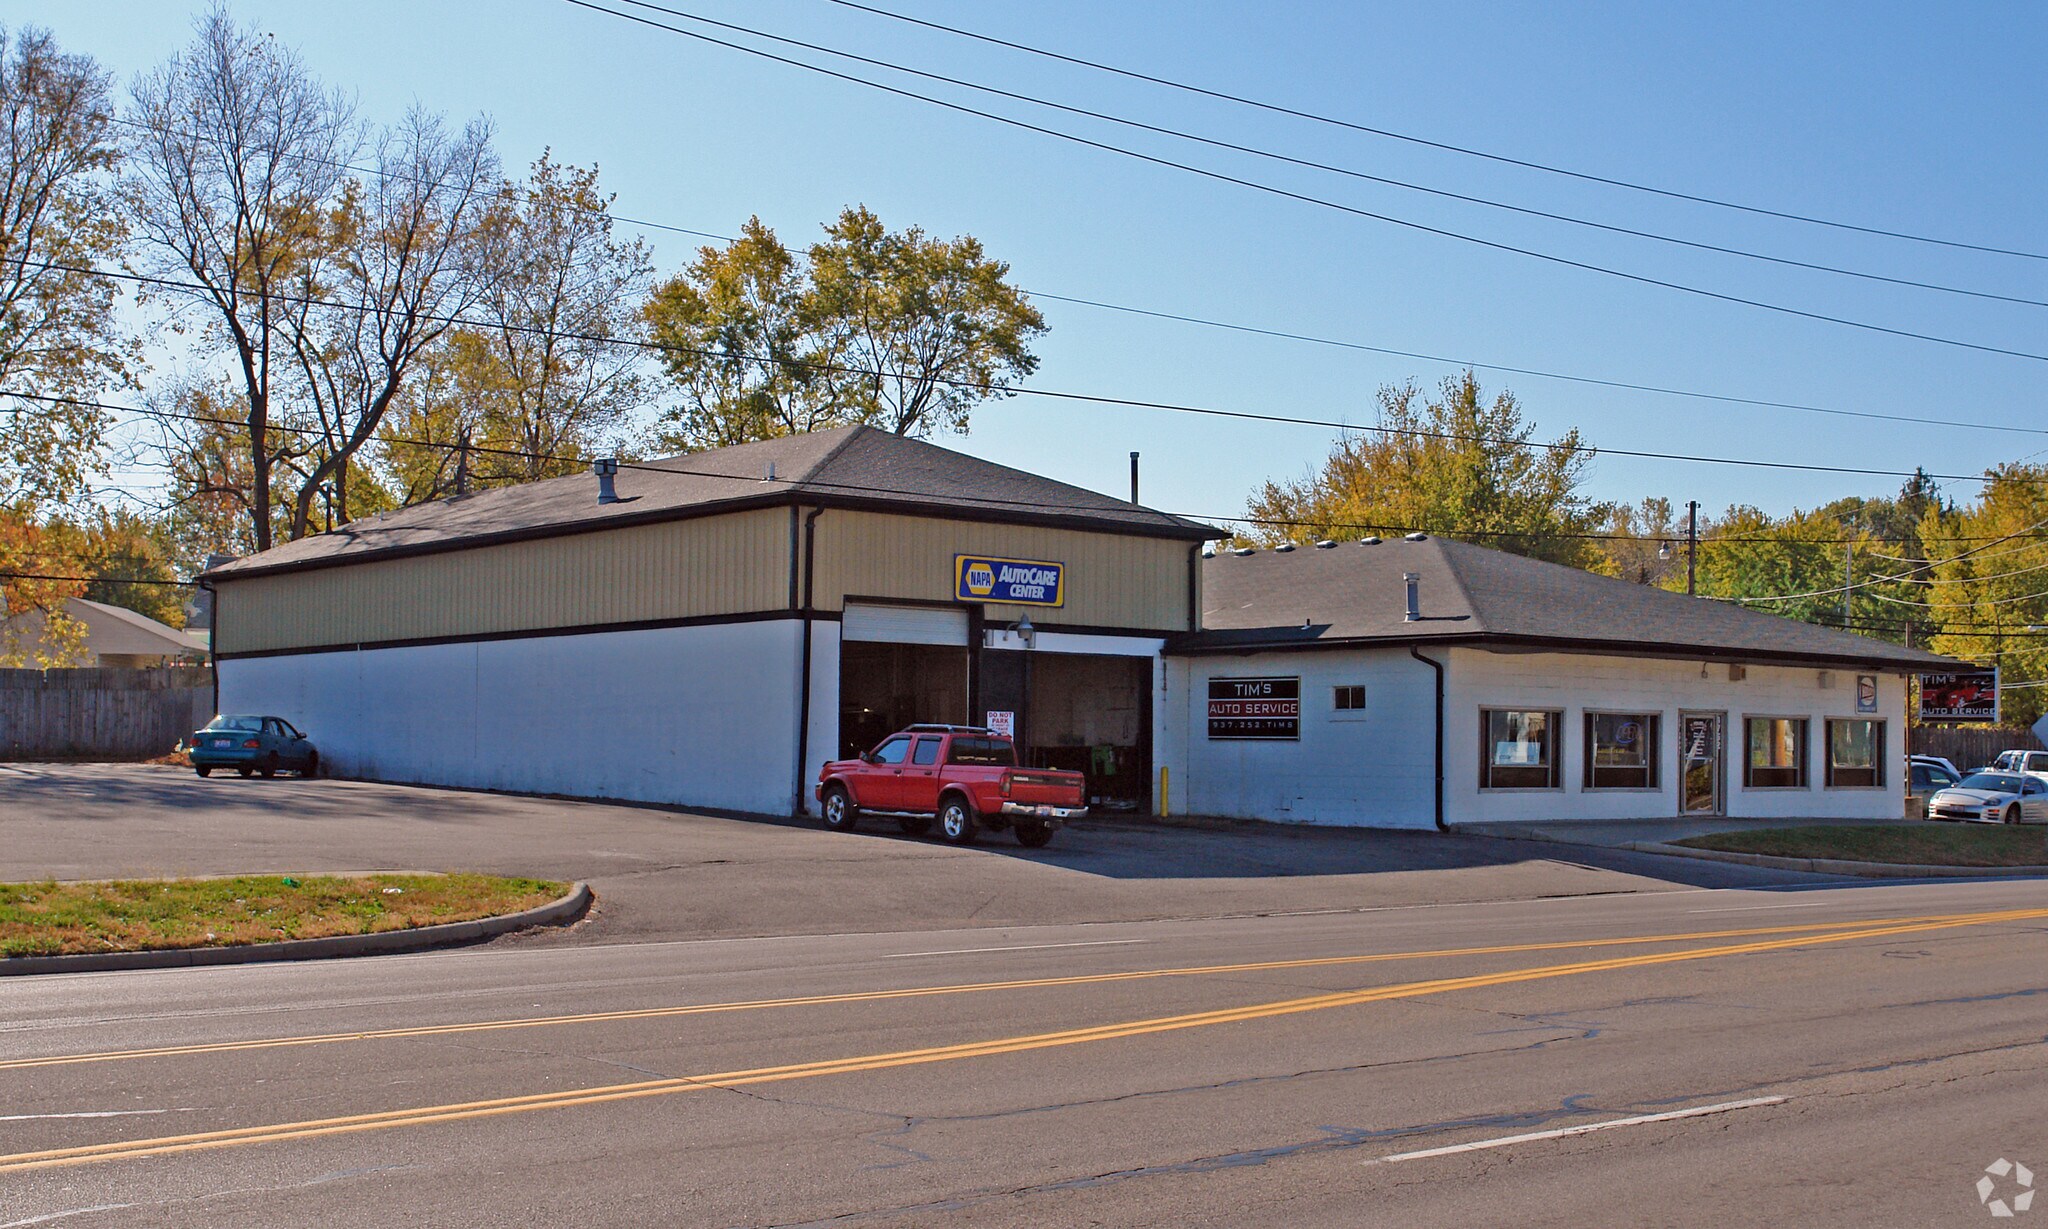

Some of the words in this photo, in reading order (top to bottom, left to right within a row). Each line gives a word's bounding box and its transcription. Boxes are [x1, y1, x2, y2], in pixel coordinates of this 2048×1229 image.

[970, 571, 991, 586] NAPA
[1009, 584, 1045, 599] CENTER
[1923, 674, 1956, 684] TIM'S
[1234, 681, 1272, 696] TIM'S
[1210, 704, 1240, 714] AUTO
[1245, 703, 1298, 714] SERVICE
